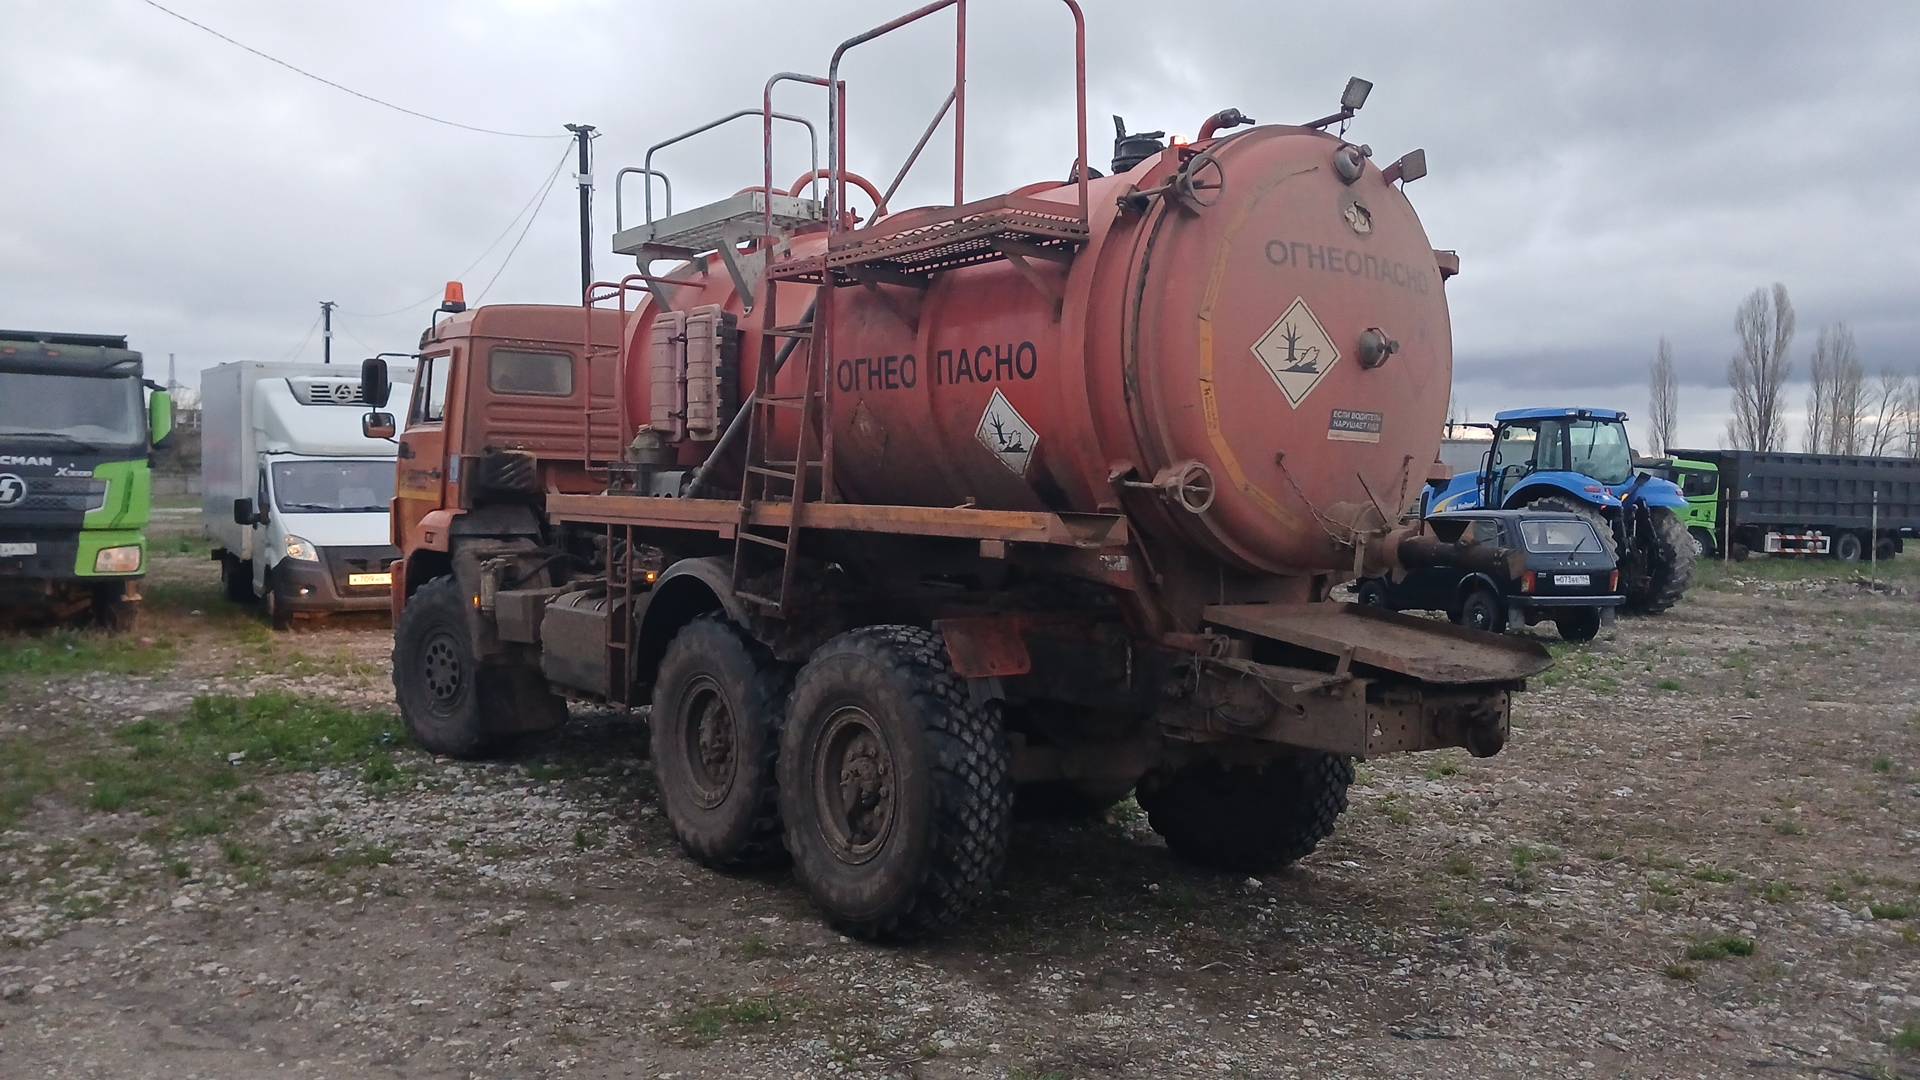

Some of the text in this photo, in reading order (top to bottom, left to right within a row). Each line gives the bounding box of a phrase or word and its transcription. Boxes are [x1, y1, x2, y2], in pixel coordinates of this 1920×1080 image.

[1264, 239, 1429, 294] ОГНЕОПАСНО
[837, 341, 1038, 392] ОГНЕО ПАСНО
